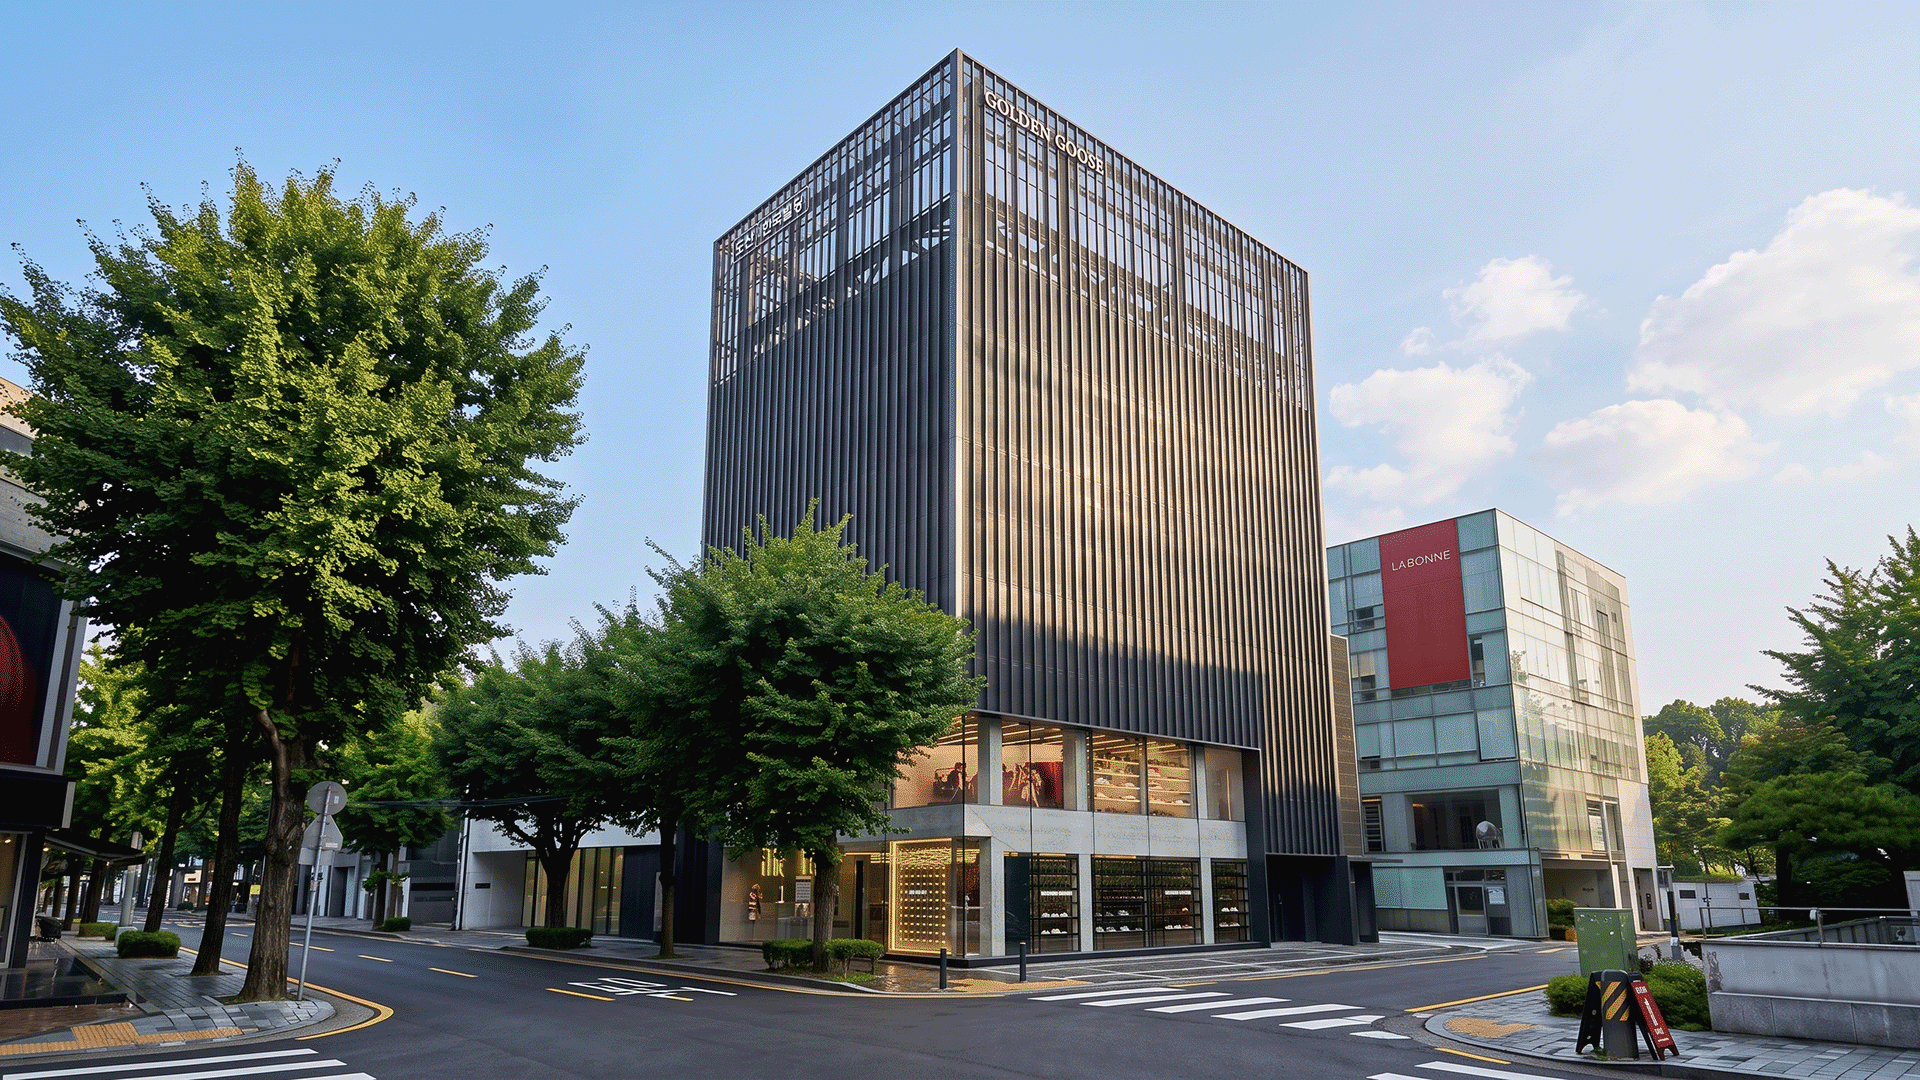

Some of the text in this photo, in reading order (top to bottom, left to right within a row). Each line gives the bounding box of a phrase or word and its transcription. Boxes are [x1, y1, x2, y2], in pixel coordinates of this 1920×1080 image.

[985, 91, 1104, 175] GOLDEN GOOSE
[735, 232, 755, 257] 도산
[1391, 549, 1451, 571] LABONNE
